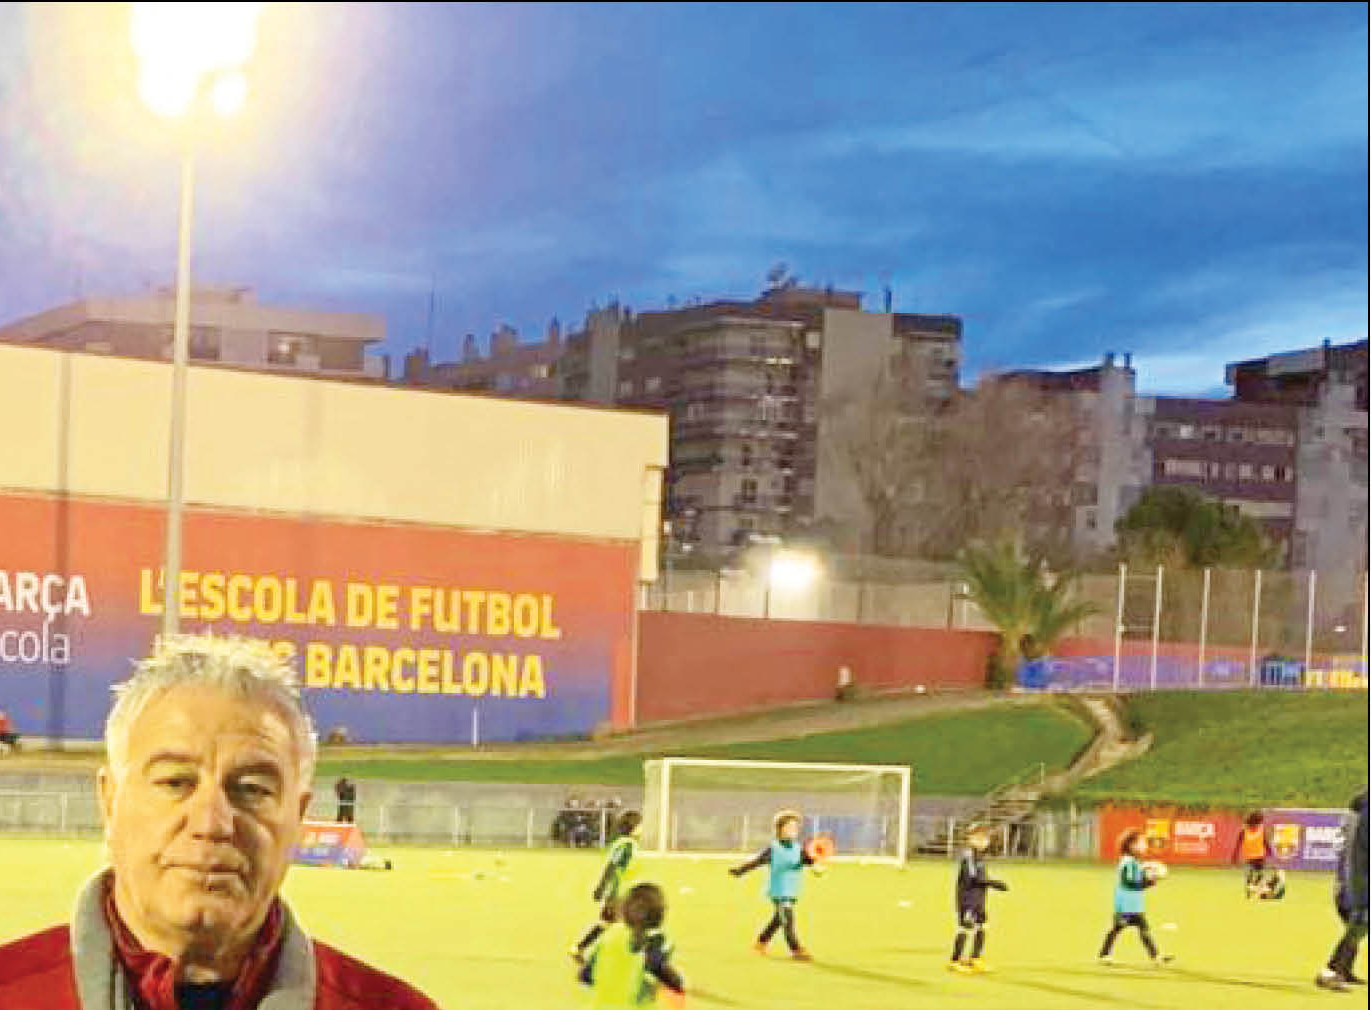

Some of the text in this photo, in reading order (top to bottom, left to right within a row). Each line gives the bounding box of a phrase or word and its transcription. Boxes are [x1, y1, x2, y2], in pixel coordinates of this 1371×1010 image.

[139, 568, 562, 640] L'ESCOLA DE FUTBOL
[305, 641, 547, 699] BARCELONA
